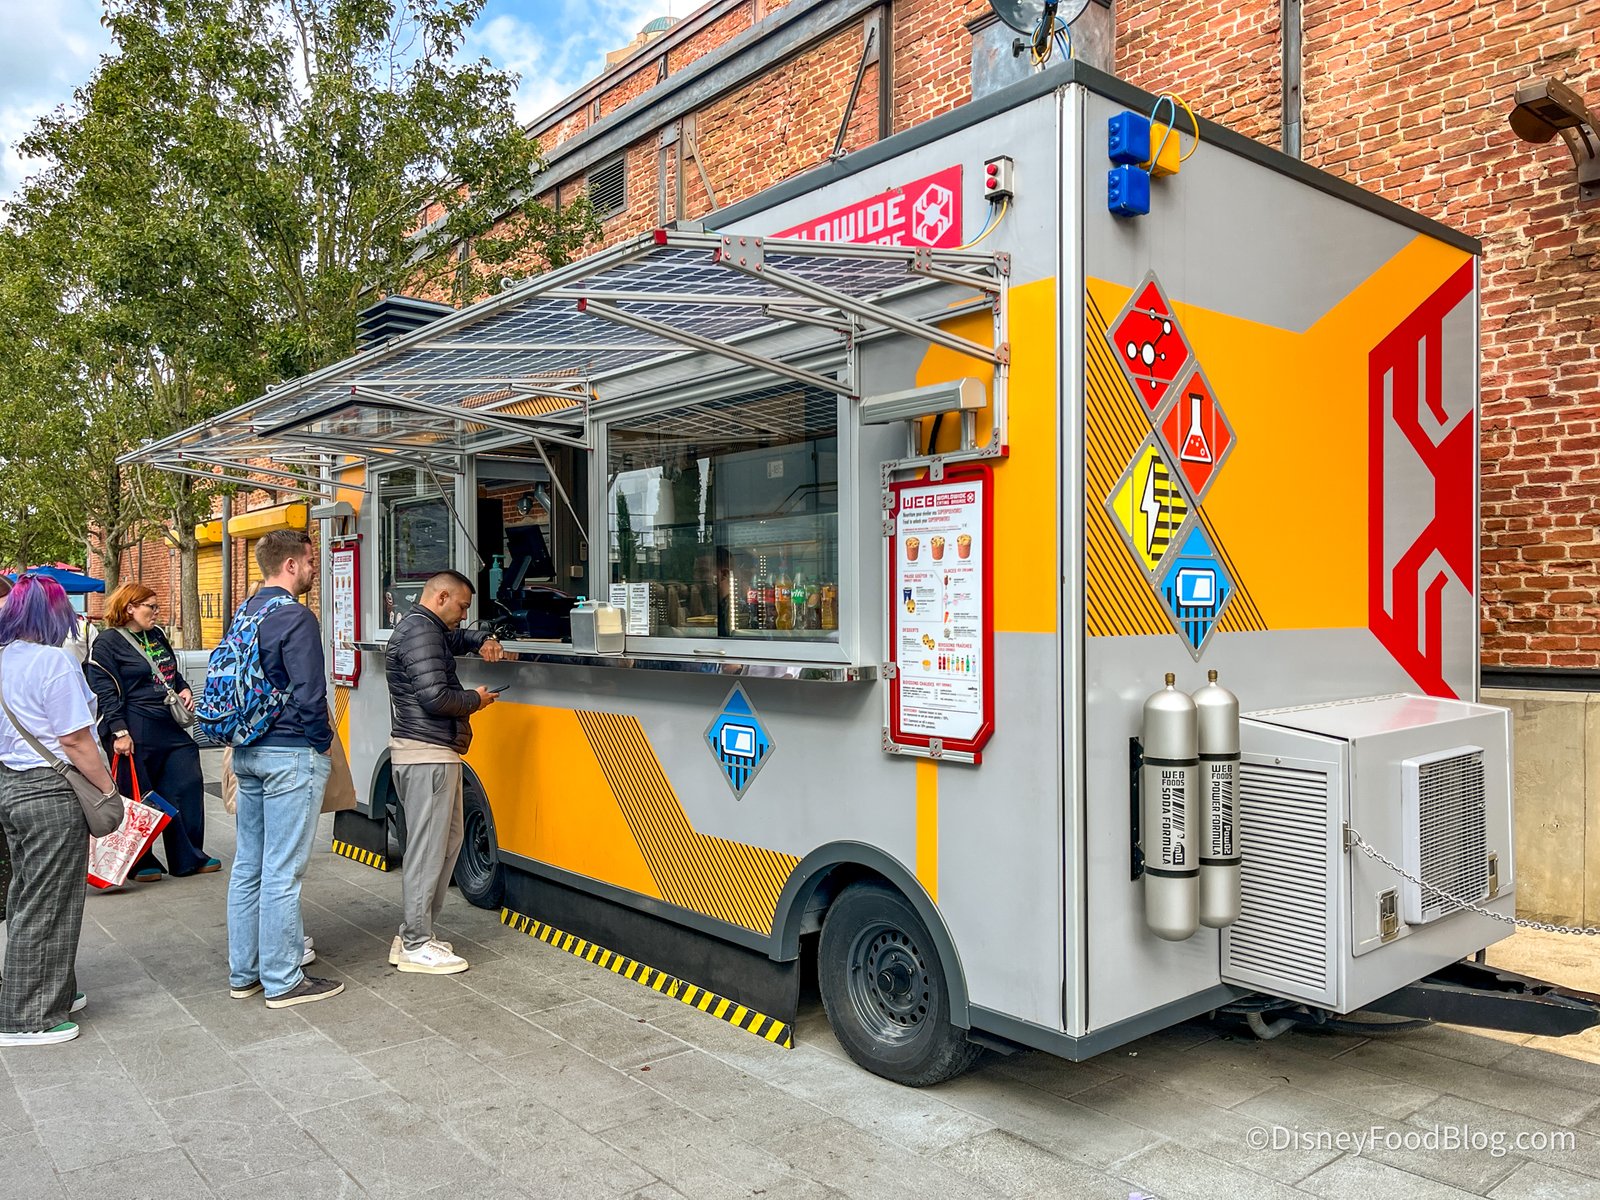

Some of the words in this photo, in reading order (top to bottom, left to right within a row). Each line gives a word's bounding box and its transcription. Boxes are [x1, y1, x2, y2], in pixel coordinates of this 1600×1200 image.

[786, 194, 906, 243] DWIDE
[903, 496, 934, 509] WEB
[201, 593, 213, 618] CK
[1162, 771, 1184, 779] WEB
[1162, 788, 1171, 814] SODA
[1212, 781, 1220, 812] POWER
[1162, 817, 1171, 864] FORMULA
[1212, 815, 1220, 856] FORMULA
